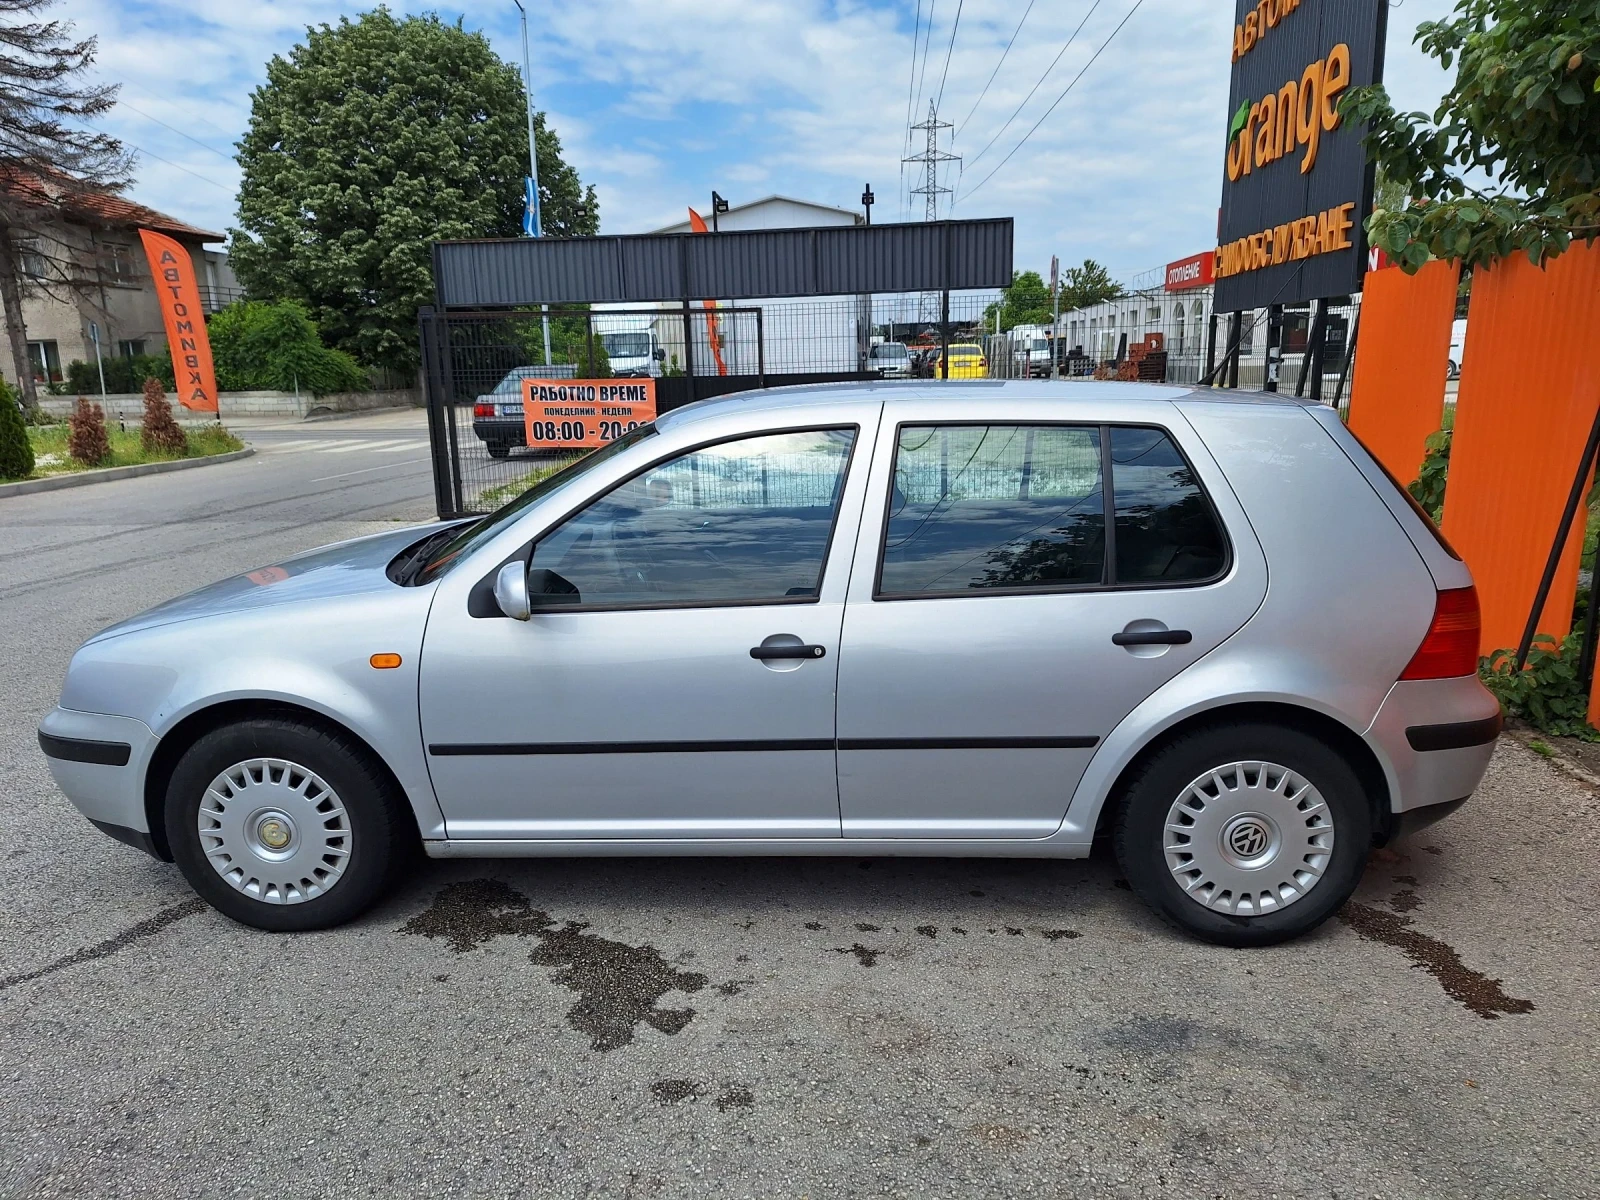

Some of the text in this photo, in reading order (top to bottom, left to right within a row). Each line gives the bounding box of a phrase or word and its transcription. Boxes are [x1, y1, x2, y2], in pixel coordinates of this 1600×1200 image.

[1228, 43, 1350, 182] orange
[1211, 202, 1355, 279] САМООБСЛУЖВАНЕ
[1168, 261, 1200, 285] ОТОПЛЕНИЕ
[530, 385, 647, 402] РАБОТНО ВРЕМЕ
[544, 407, 596, 417] ПОНЕДЕЛНИК
[601, 407, 632, 417] НЕДЕЛЯ
[532, 421, 585, 441] 08:00
